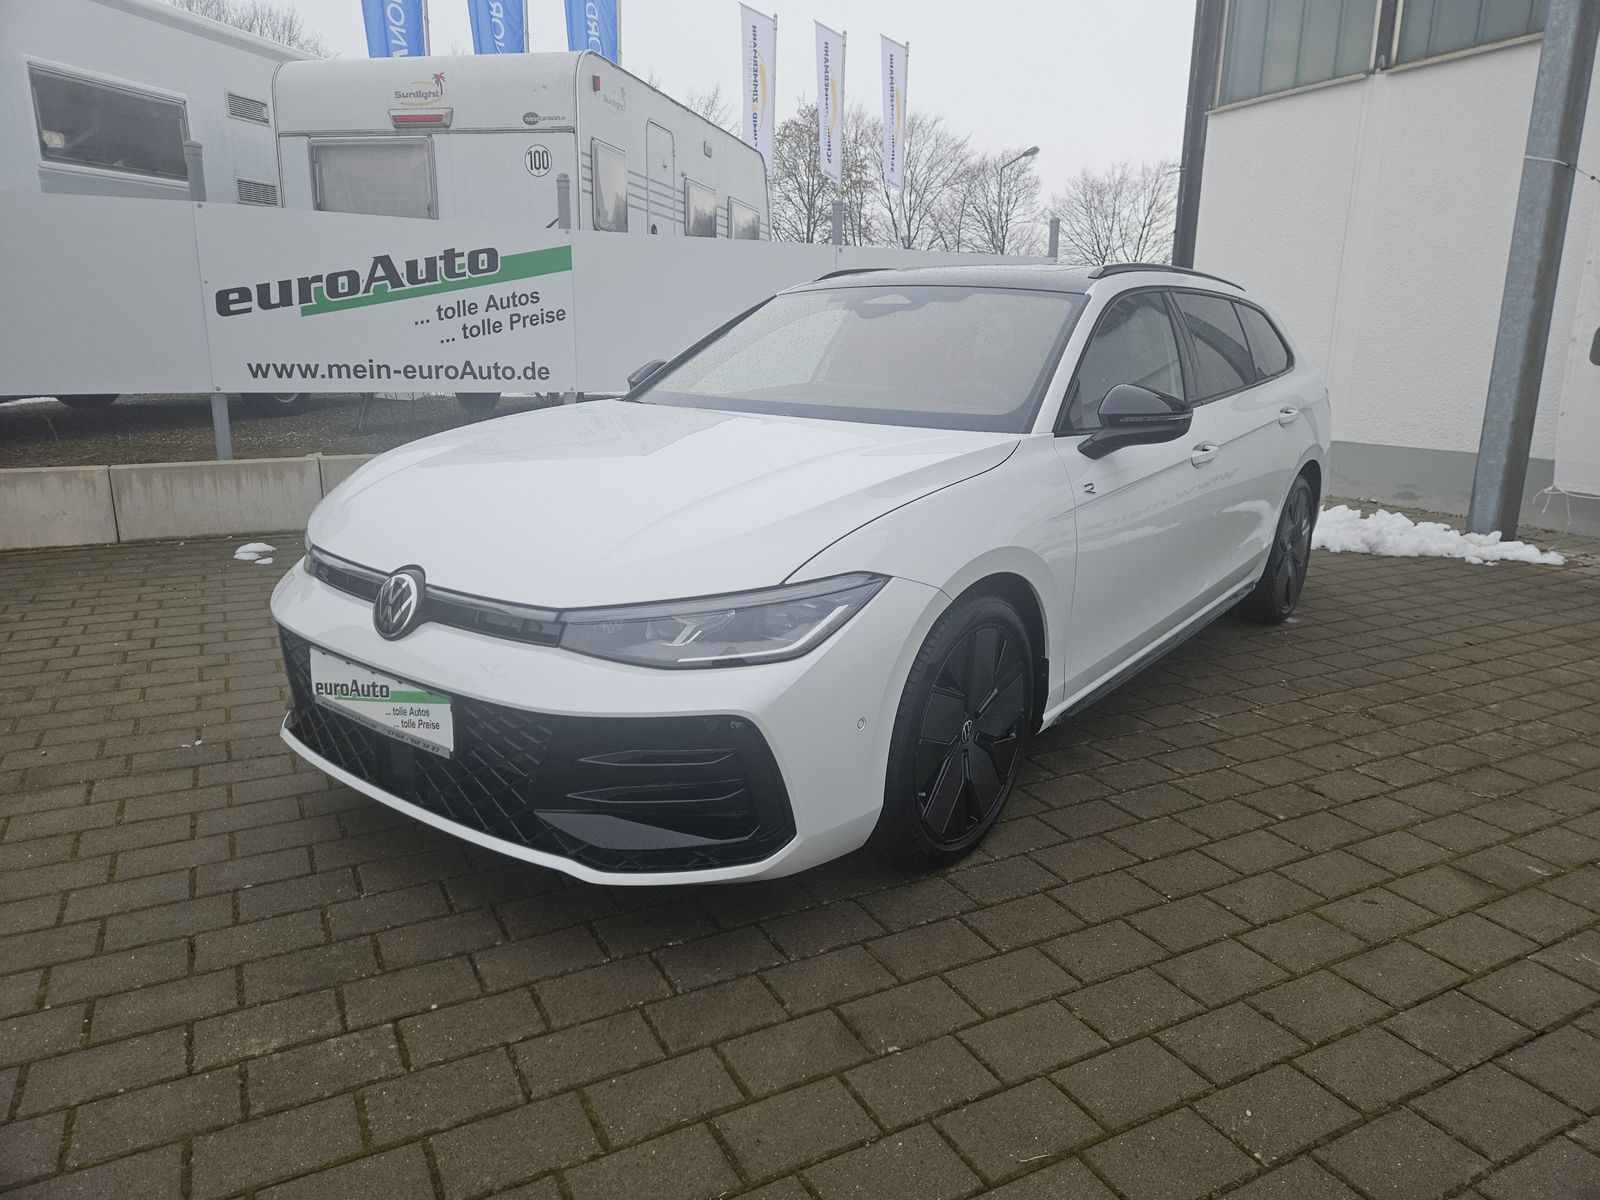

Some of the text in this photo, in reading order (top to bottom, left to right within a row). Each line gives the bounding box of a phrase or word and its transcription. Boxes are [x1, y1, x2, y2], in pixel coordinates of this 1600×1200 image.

[394, 90, 440, 100] Sunlight
[528, 150, 549, 170] 100
[214, 247, 499, 317] euroAuto
[436, 299, 478, 321] tolle
[485, 291, 540, 313] Autos
[462, 318, 503, 339] tolle
[509, 308, 566, 331] Preise
[247, 359, 551, 380] www.mein-euroAuto.de
[315, 679, 390, 698] euroAuto
[392, 706, 408, 717] tolle
[409, 706, 431, 717] Autos
[401, 719, 416, 729] tolle
[417, 720, 440, 731] Preise
